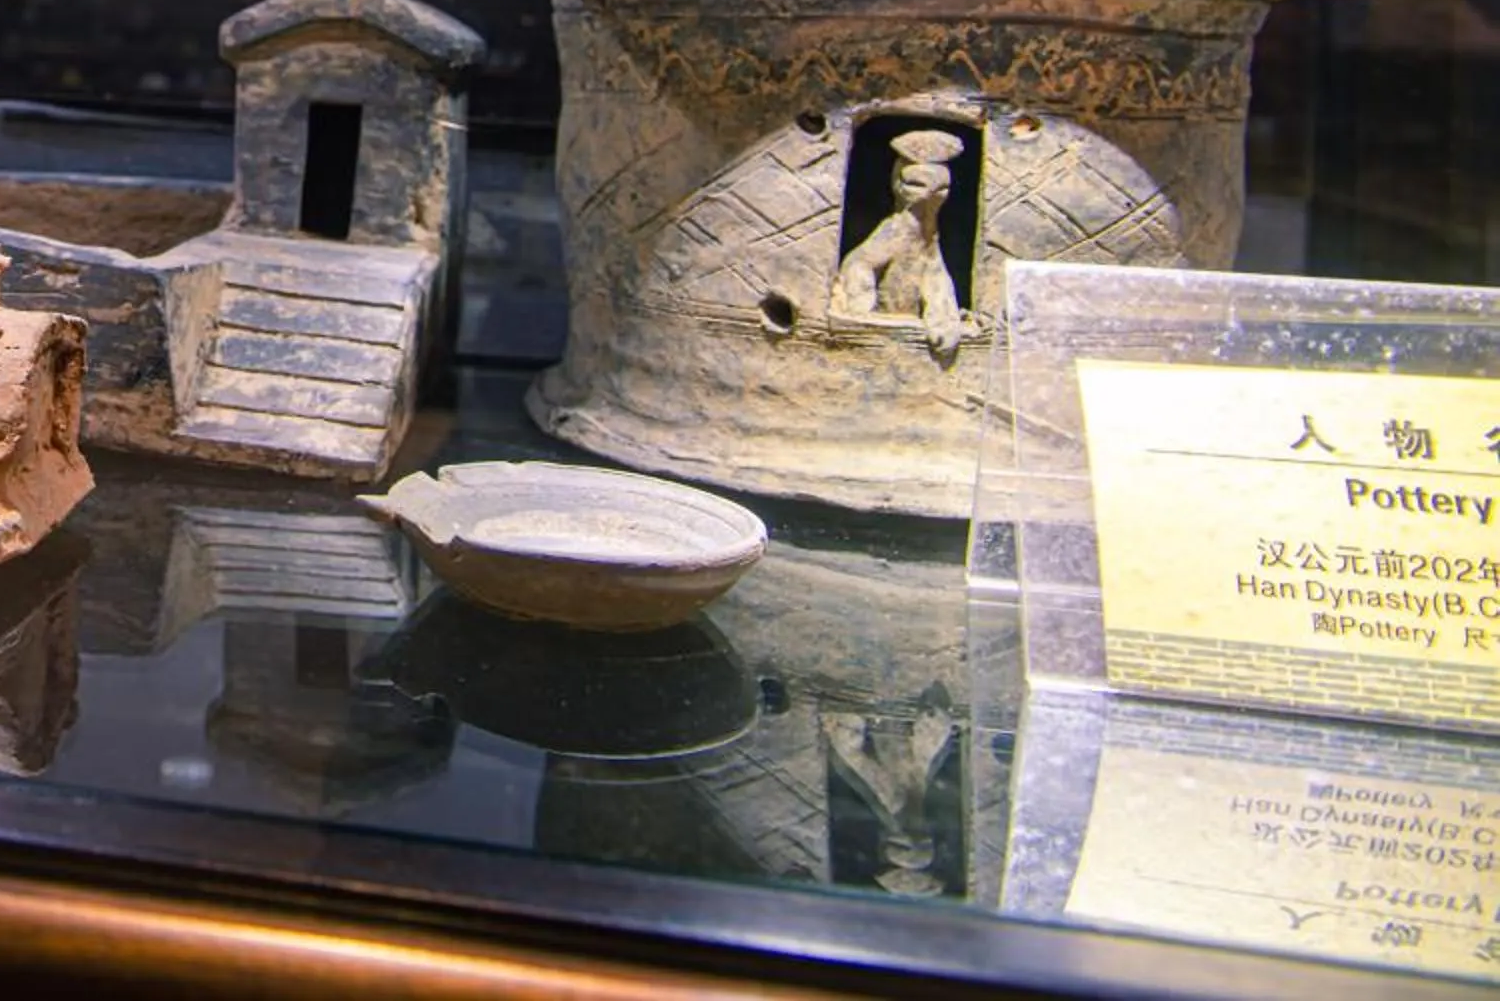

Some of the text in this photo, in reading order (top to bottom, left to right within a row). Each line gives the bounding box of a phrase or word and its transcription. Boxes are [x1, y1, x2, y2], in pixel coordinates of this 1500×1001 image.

[1345, 477, 1493, 525] Pottery
[1256, 537, 1500, 587] 汉公元前202年
[1236, 573, 1296, 599] Han
[1311, 611, 1437, 648] 陶Pottery
